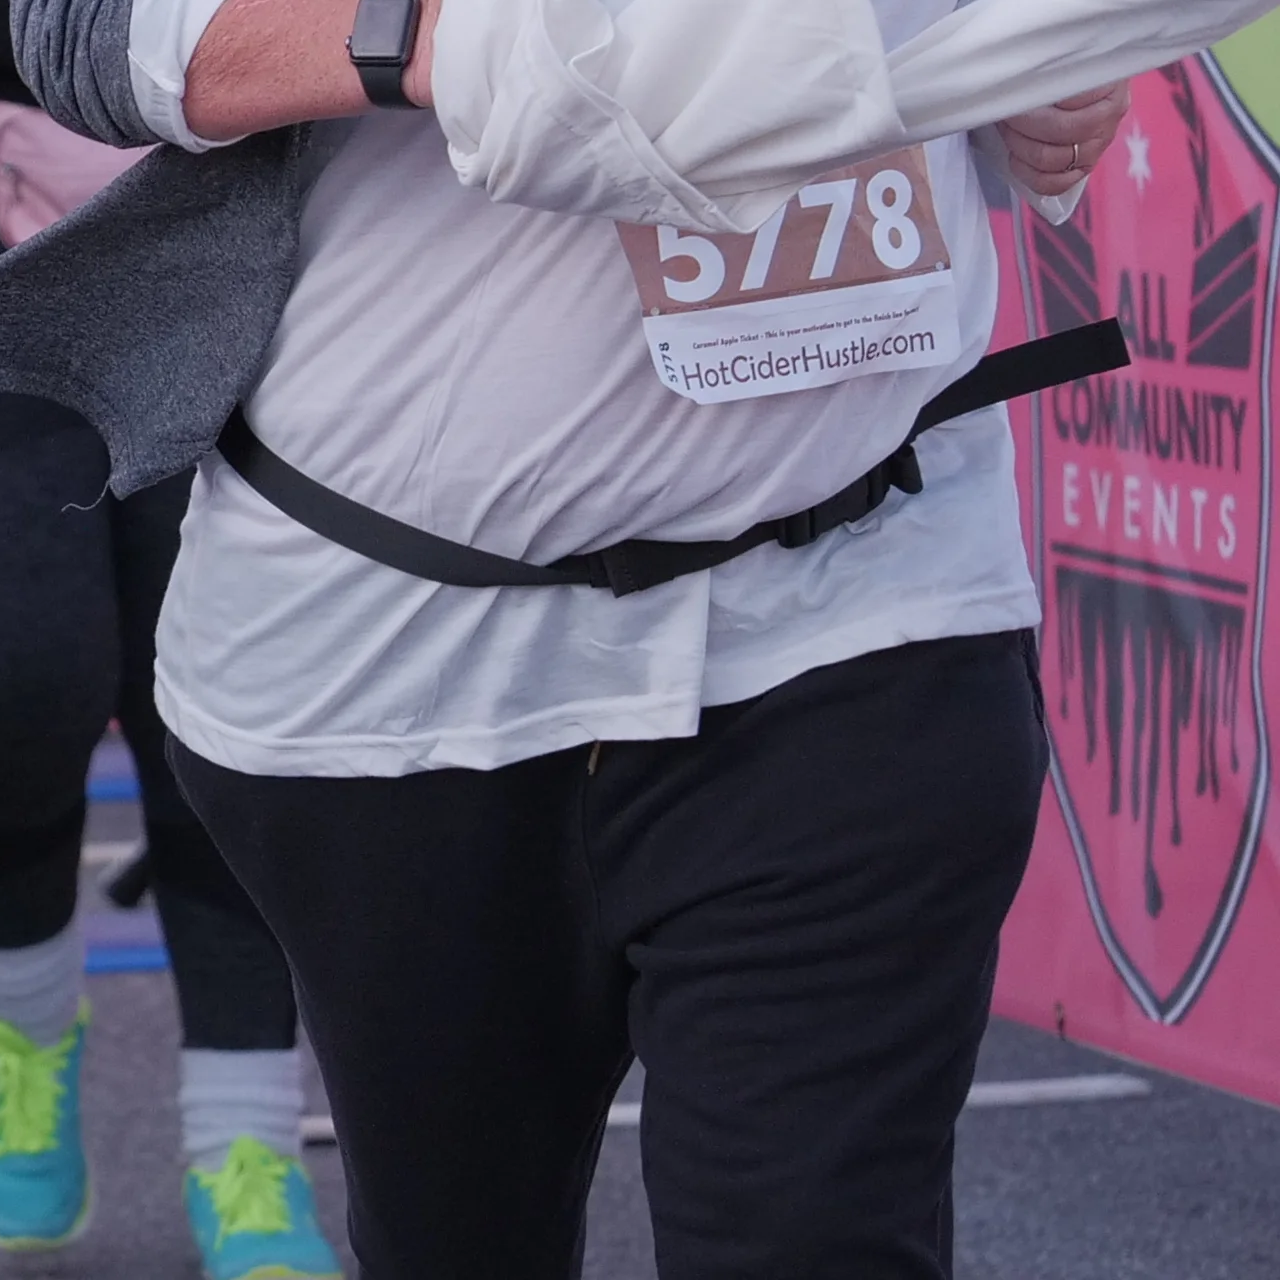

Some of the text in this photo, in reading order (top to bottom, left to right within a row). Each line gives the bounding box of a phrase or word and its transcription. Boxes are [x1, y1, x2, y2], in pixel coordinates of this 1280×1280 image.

[658, 341, 678, 383] 5778
[680, 330, 936, 391] HotCiderHustle.com
[1117, 268, 1175, 363] ALL
[1051, 374, 1247, 475] COMMUNITY
[1062, 462, 1237, 560] EVENTS
